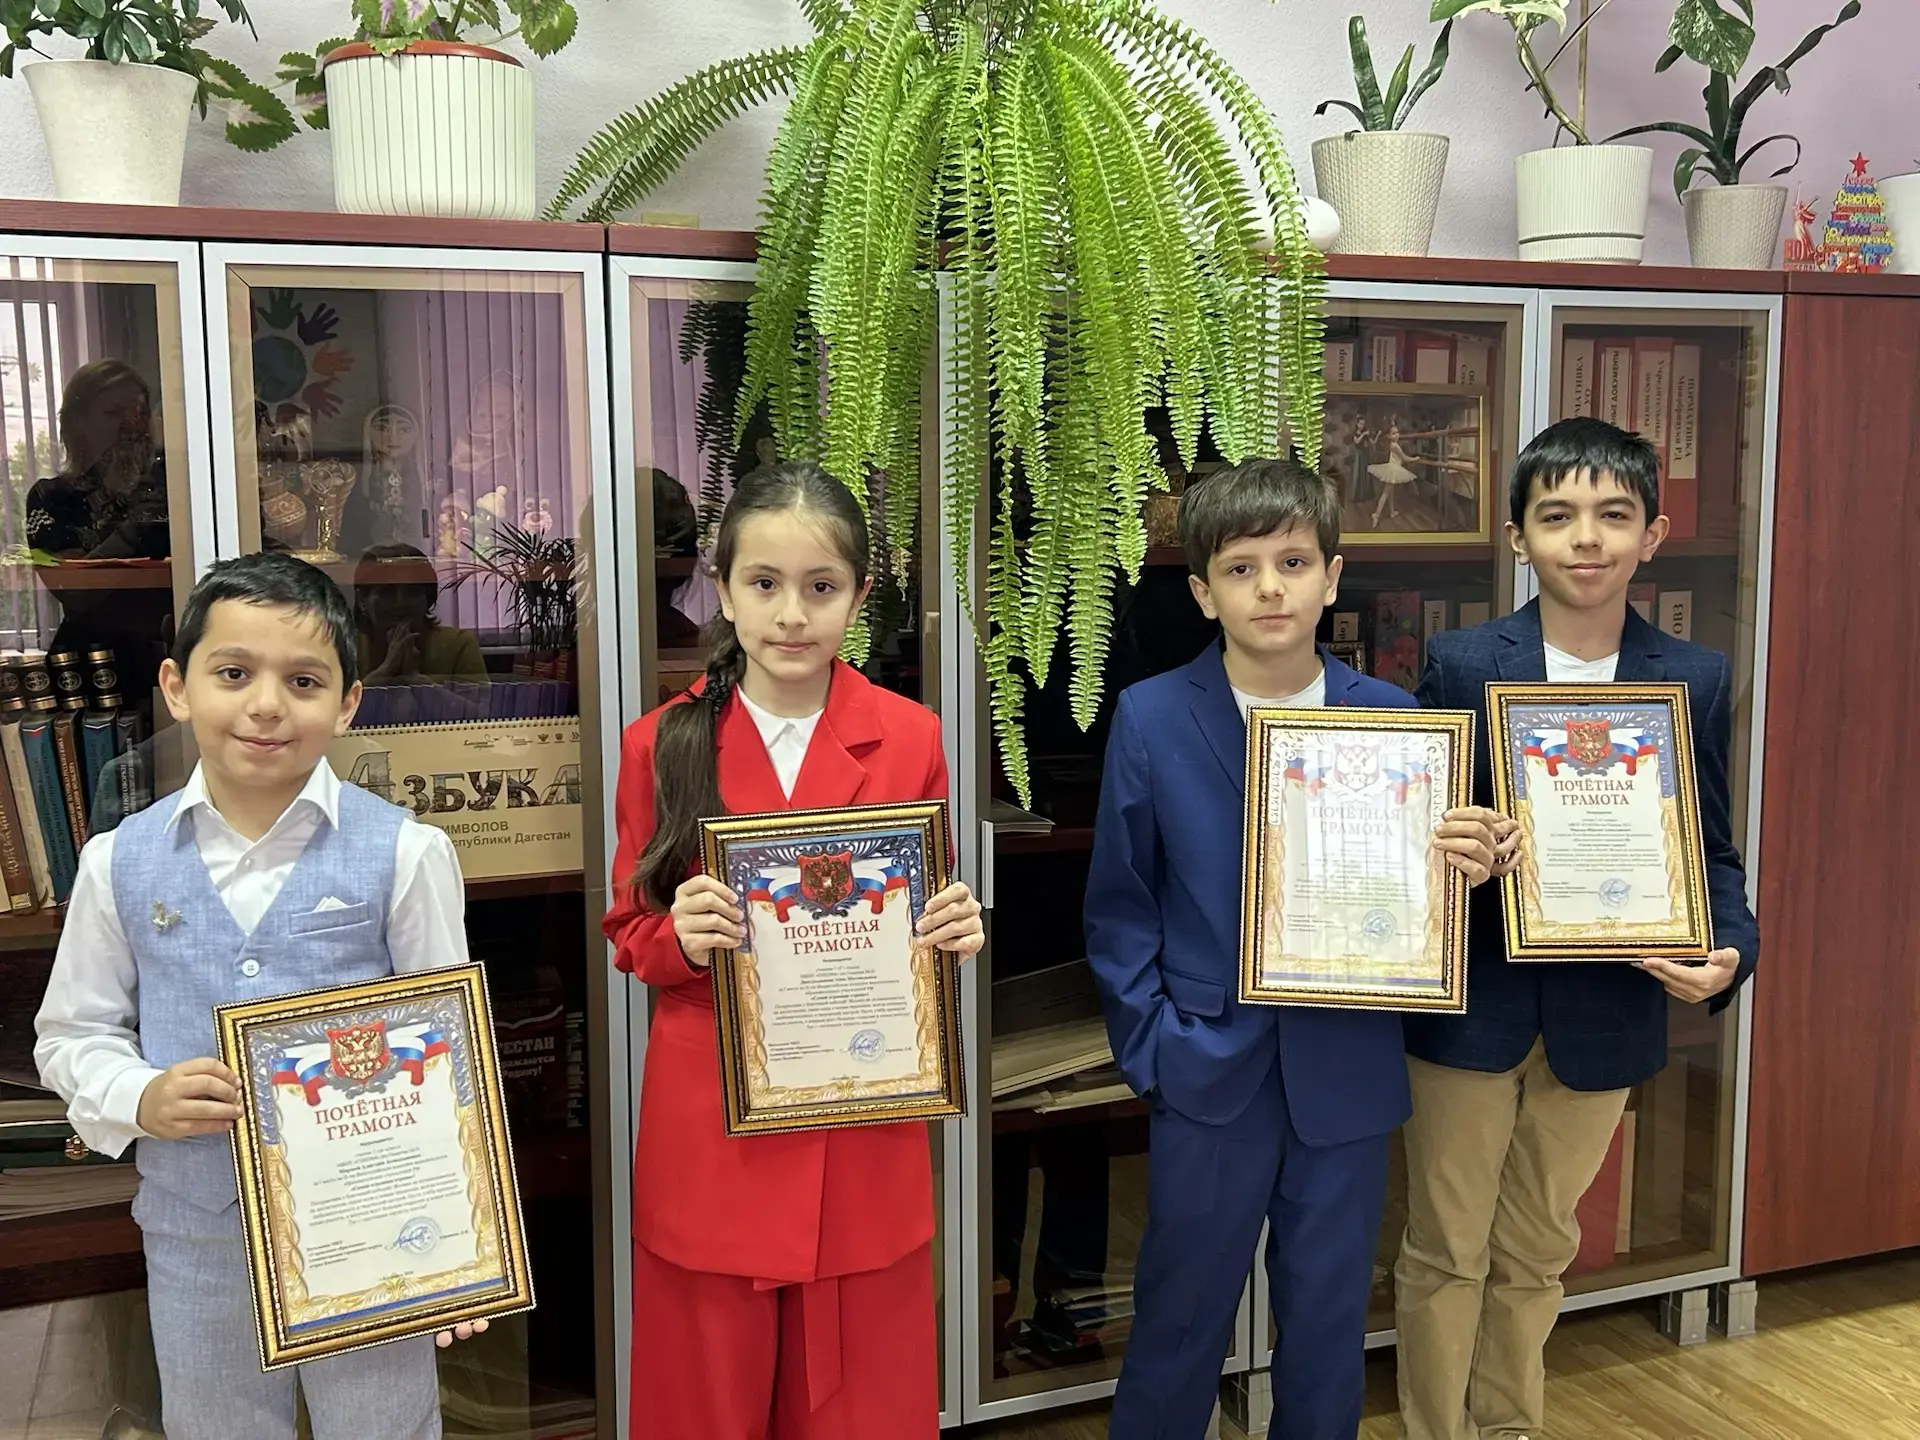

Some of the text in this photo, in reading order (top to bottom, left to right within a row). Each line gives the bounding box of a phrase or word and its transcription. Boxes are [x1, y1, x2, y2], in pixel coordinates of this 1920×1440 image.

[1611, 350, 1619, 402] ДОКУМЕНТЫ
[1575, 356, 1584, 417] МАТИВКА
[1685, 378, 1695, 458] НОРМАТИВКА
[1673, 445, 1682, 462] РД
[1672, 604, 1683, 633] ОВЗ
[1553, 778, 1635, 792] ПОЧЁТНАЯ
[1561, 794, 1630, 806] ГРАМОТА
[441, 821, 509, 835] ИМВОЛОВ
[1320, 821, 1394, 837] ГРАМОТА
[514, 830, 571, 846] Дагестан
[783, 919, 881, 940] ПОЧЁТНАЯ
[793, 938, 874, 955] ГРАМОТА
[498, 1036, 555, 1055] ЕСТАН
[314, 1090, 423, 1126] ПОЧЁТНАЯ
[326, 1112, 418, 1141] ГРАМОТА
